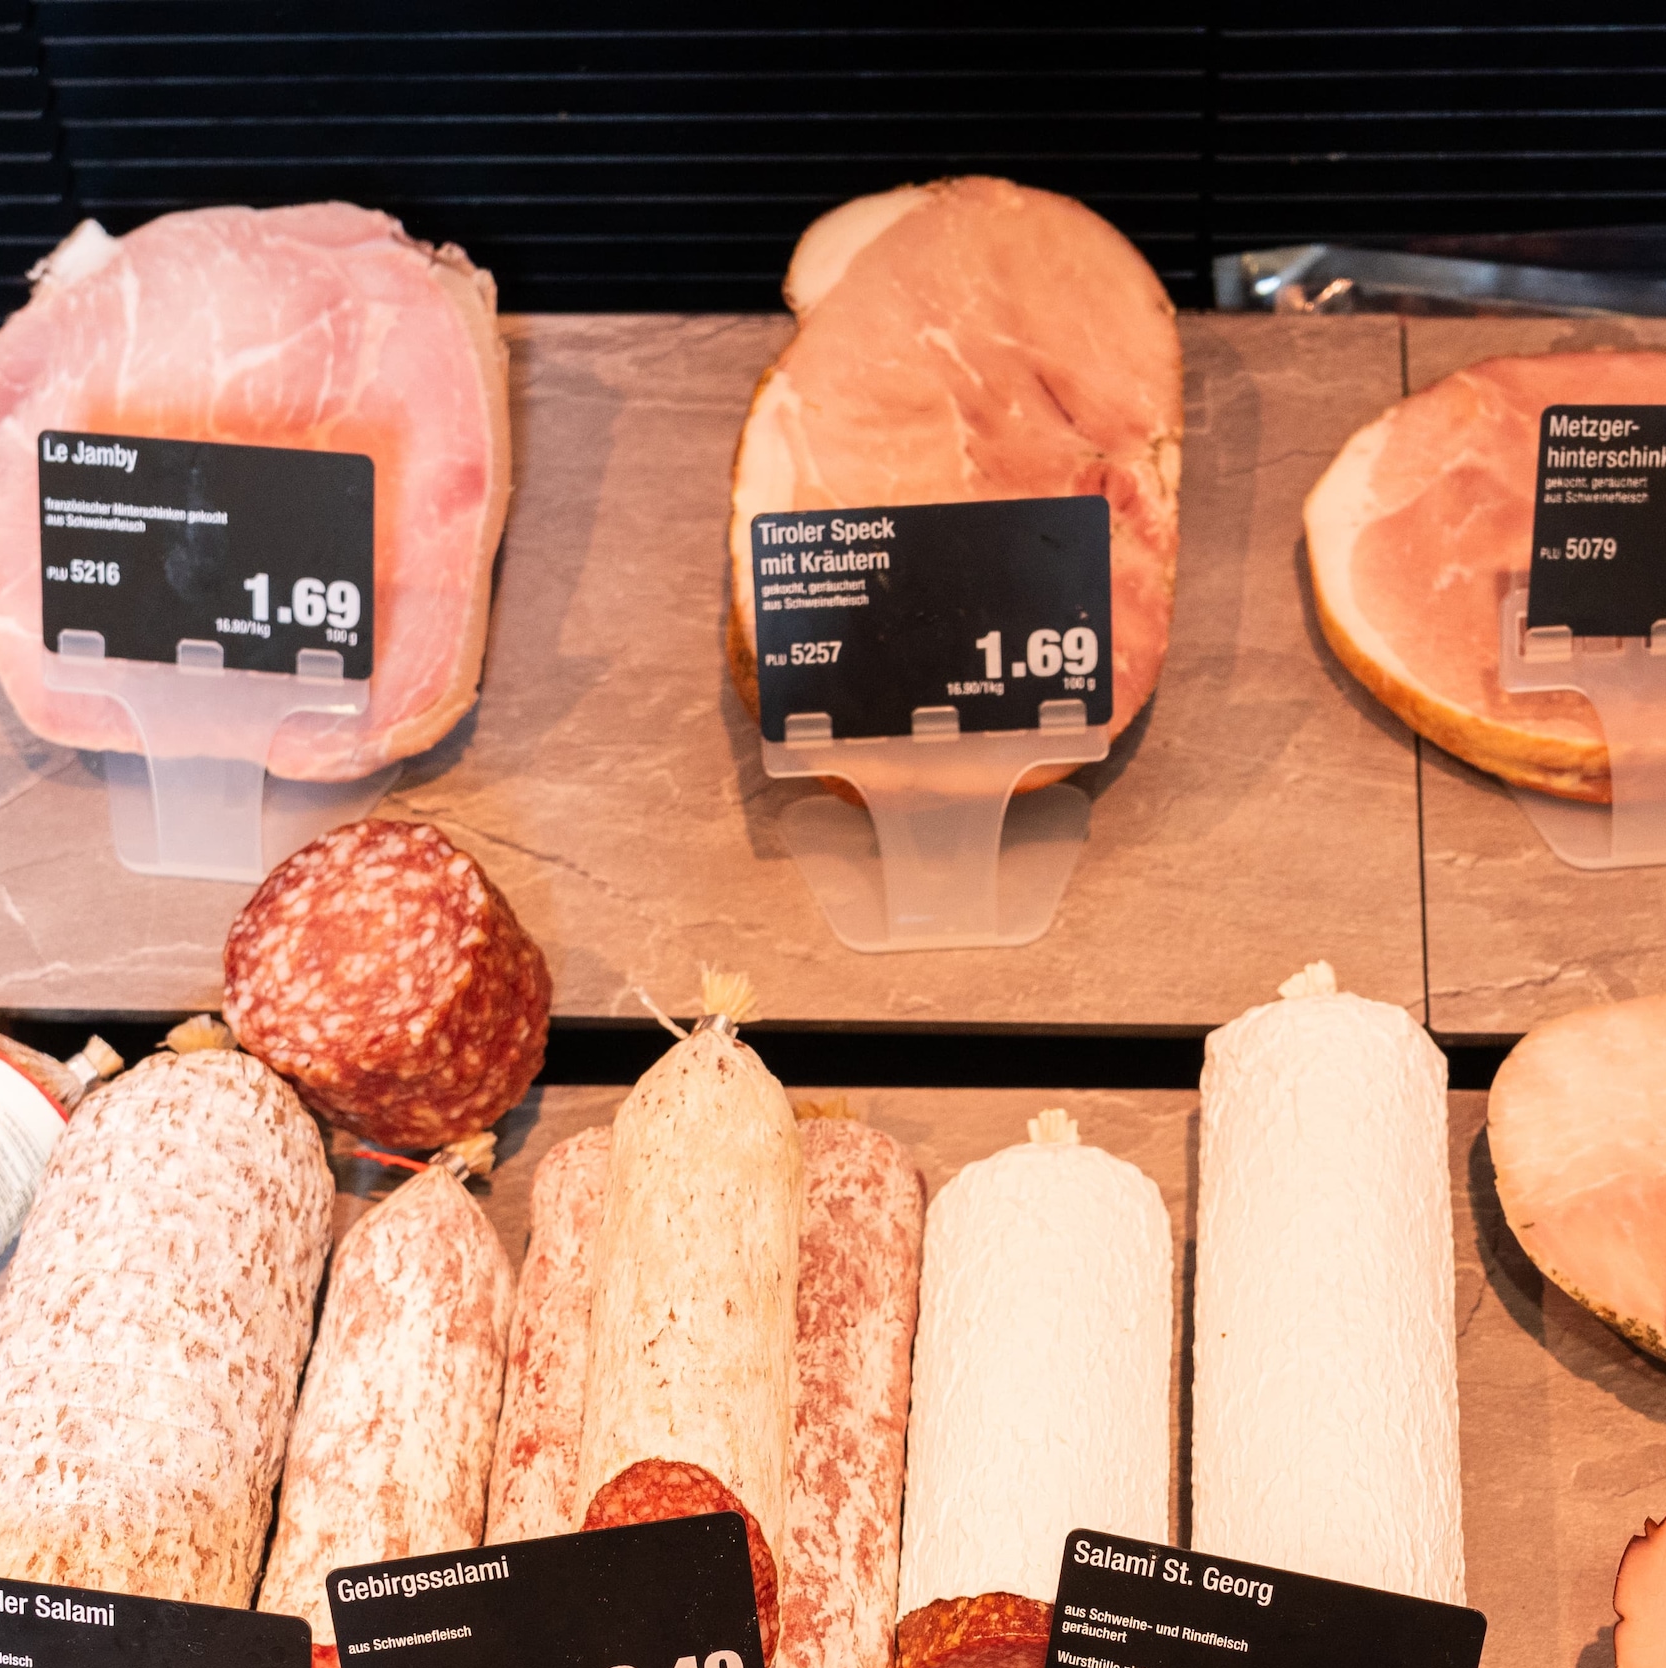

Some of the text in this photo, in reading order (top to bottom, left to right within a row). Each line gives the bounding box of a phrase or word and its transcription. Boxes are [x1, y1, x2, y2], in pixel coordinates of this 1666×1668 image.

[1549, 414, 1640, 442] Metzger-
[43, 437, 138, 473] Le Jamby
[757, 516, 896, 546] Tiroler Speck
[760, 549, 890, 576] mit Kräutern
[1565, 537, 1617, 560] 5079
[70, 558, 121, 586] 5216
[243, 572, 361, 629] 1.69
[790, 640, 842, 665] 5257
[975, 626, 1099, 679] 1.69
[337, 1555, 510, 1603] Gebirgssalami
[1073, 1539, 1274, 1607] Salami St. Georg
[34, 1594, 115, 1627] Salami
[1062, 1620, 1127, 1644] geräuchert
[1064, 1605, 1249, 1653] aus Schweine- und Rindfleisch
